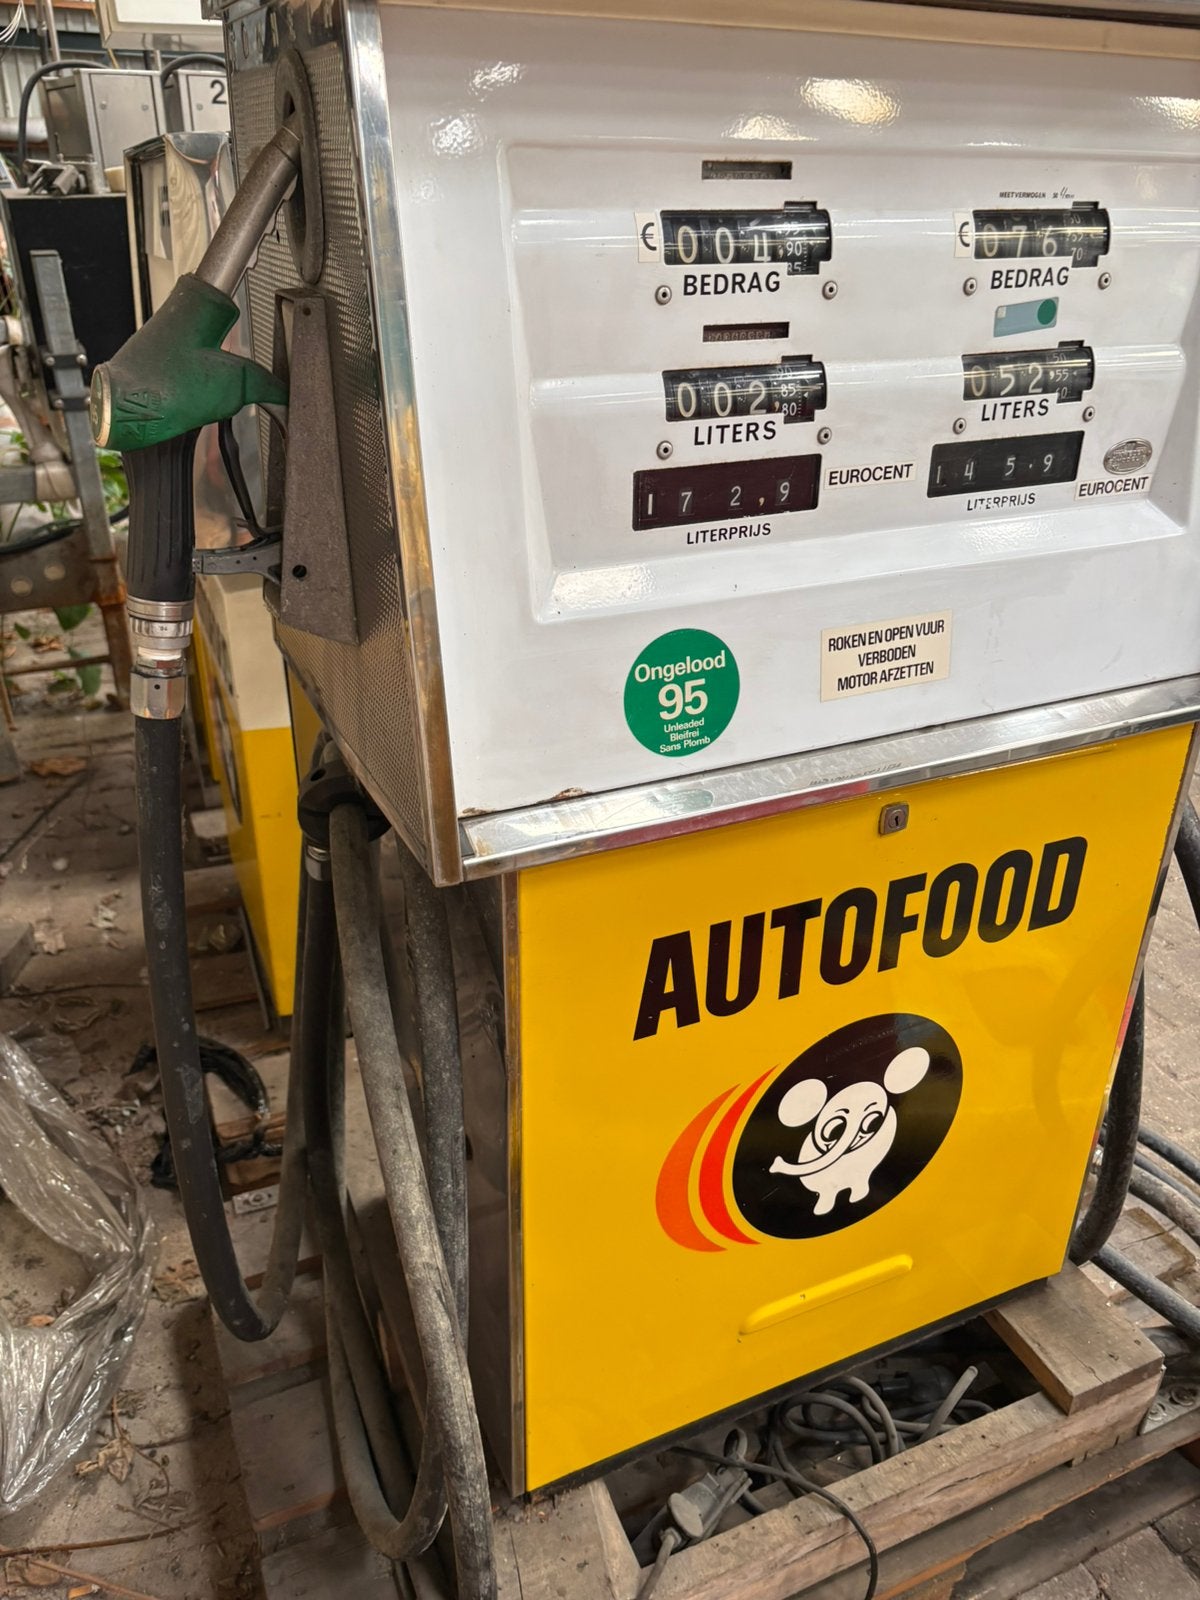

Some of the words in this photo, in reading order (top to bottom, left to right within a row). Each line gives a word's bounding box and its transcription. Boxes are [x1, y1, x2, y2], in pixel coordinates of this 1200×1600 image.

[210, 79, 227, 104] 2
[683, 271, 780, 296] BEDRAG
[990, 266, 1070, 290] BEDRAG
[981, 398, 1050, 422] LITERS
[694, 420, 777, 446] LITERS
[828, 463, 914, 486] EUROCENT
[1078, 476, 1149, 498] EUROCENT
[966, 492, 1036, 511] LITERPRIJS
[686, 522, 772, 545] LITERPRIJS
[828, 632, 866, 652] ROKEN
[868, 629, 883, 646] EN
[884, 624, 914, 643] OPEN
[915, 619, 945, 637] VUUR
[634, 650, 726, 683] Ongelood
[858, 644, 916, 667] VERBODEN
[837, 671, 878, 691] MOTOR
[879, 661, 934, 683] AFZETTEN
[658, 678, 708, 720] 95
[663, 717, 705, 733] Unleaded
[669, 729, 700, 742] Bleifrei
[660, 742, 681, 753] Sans
[683, 735, 711, 749] Plomb
[633, 836, 1088, 1041] AUTOFOOD
